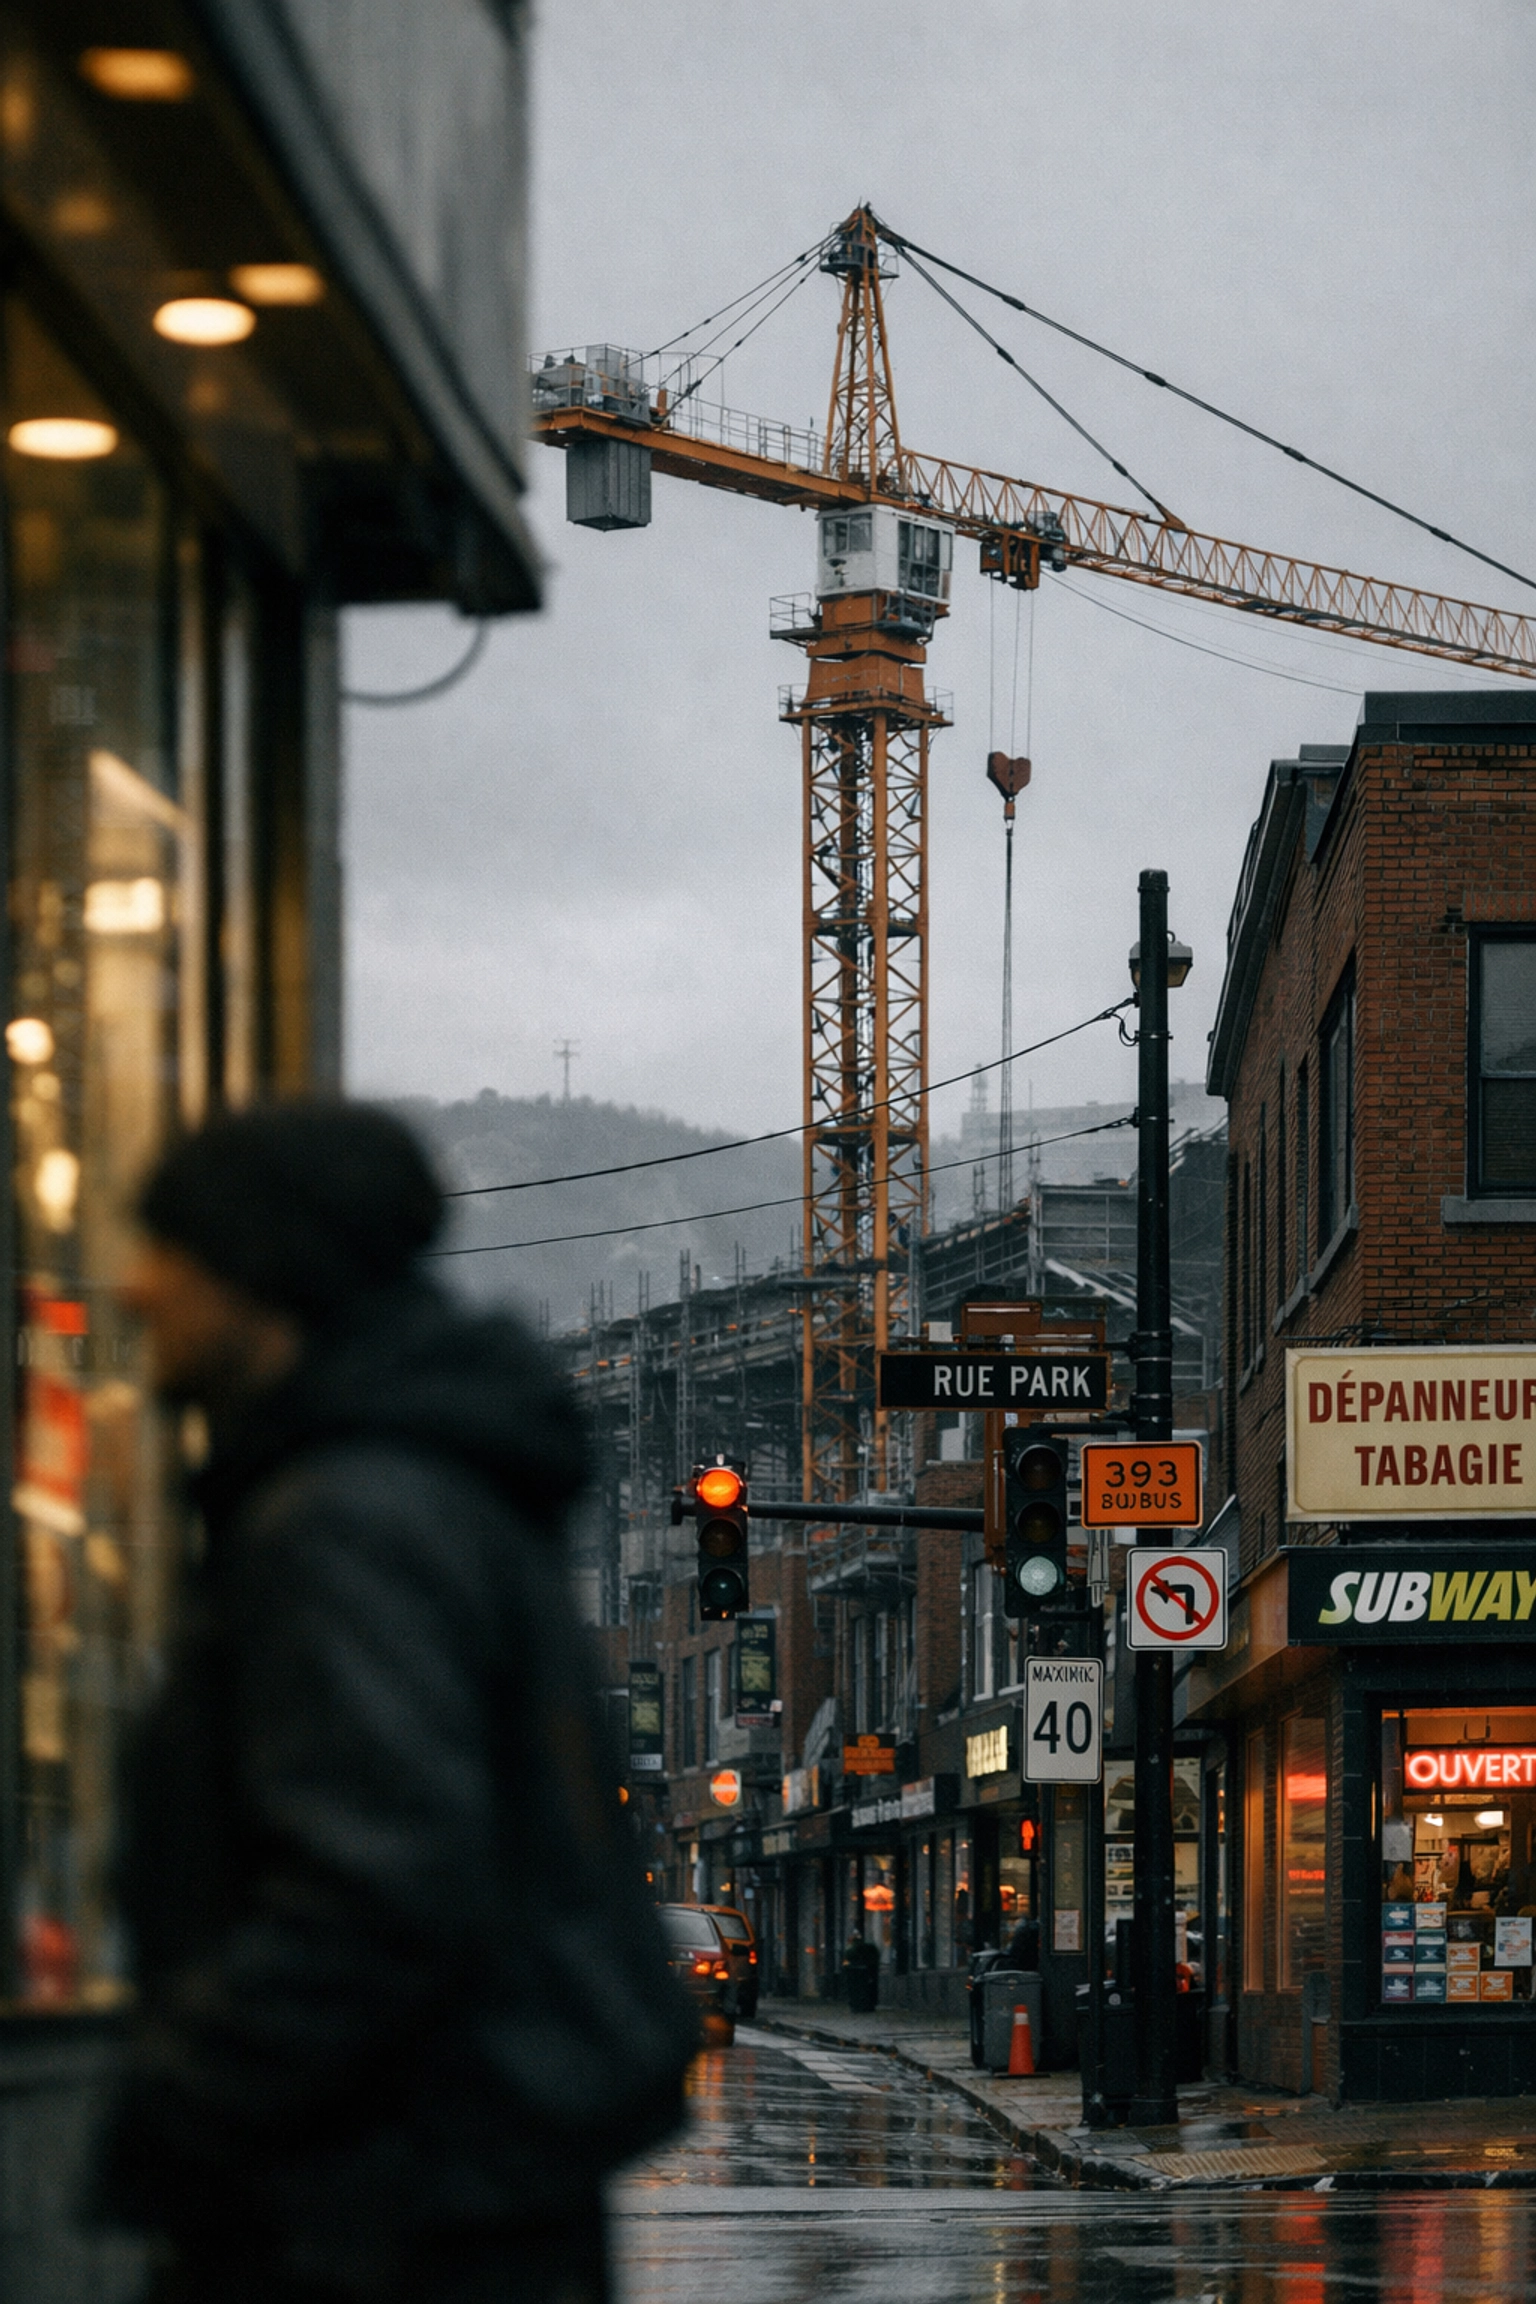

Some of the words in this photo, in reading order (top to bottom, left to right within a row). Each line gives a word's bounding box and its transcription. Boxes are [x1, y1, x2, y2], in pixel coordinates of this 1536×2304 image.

[934, 1365, 994, 1397] RUE
[1010, 1365, 1091, 1397] PARK
[1105, 1461, 1178, 1488] 393
[1354, 1443, 1523, 1486] TABAGIE
[1318, 1571, 1536, 1625] SUBWAY
[1033, 1701, 1092, 1754] 40
[1408, 1753, 1536, 1783] OUVERT
